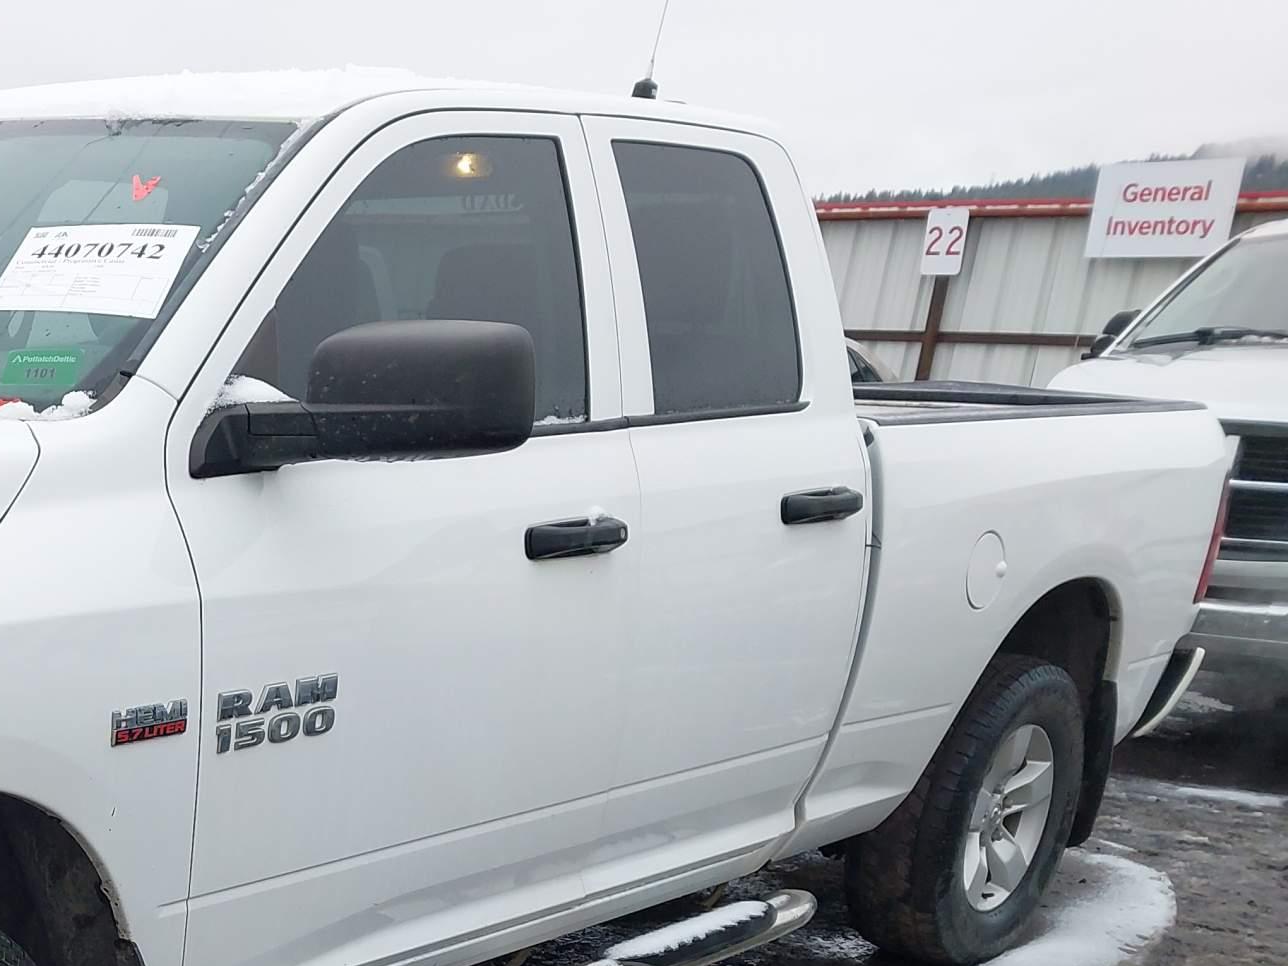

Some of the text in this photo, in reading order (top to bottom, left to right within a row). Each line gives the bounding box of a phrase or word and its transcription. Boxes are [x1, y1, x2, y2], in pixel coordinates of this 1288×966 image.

[1121, 179, 1213, 204] General
[924, 225, 964, 256] 22
[1105, 216, 1215, 240] Inventory
[31, 242, 166, 260] 44070742
[25, 367, 56, 379] 1101
[216, 672, 339, 722] RAM
[111, 698, 188, 731] HEMI
[116, 720, 186, 743] 5.7 LITER
[215, 704, 336, 755] 1500
